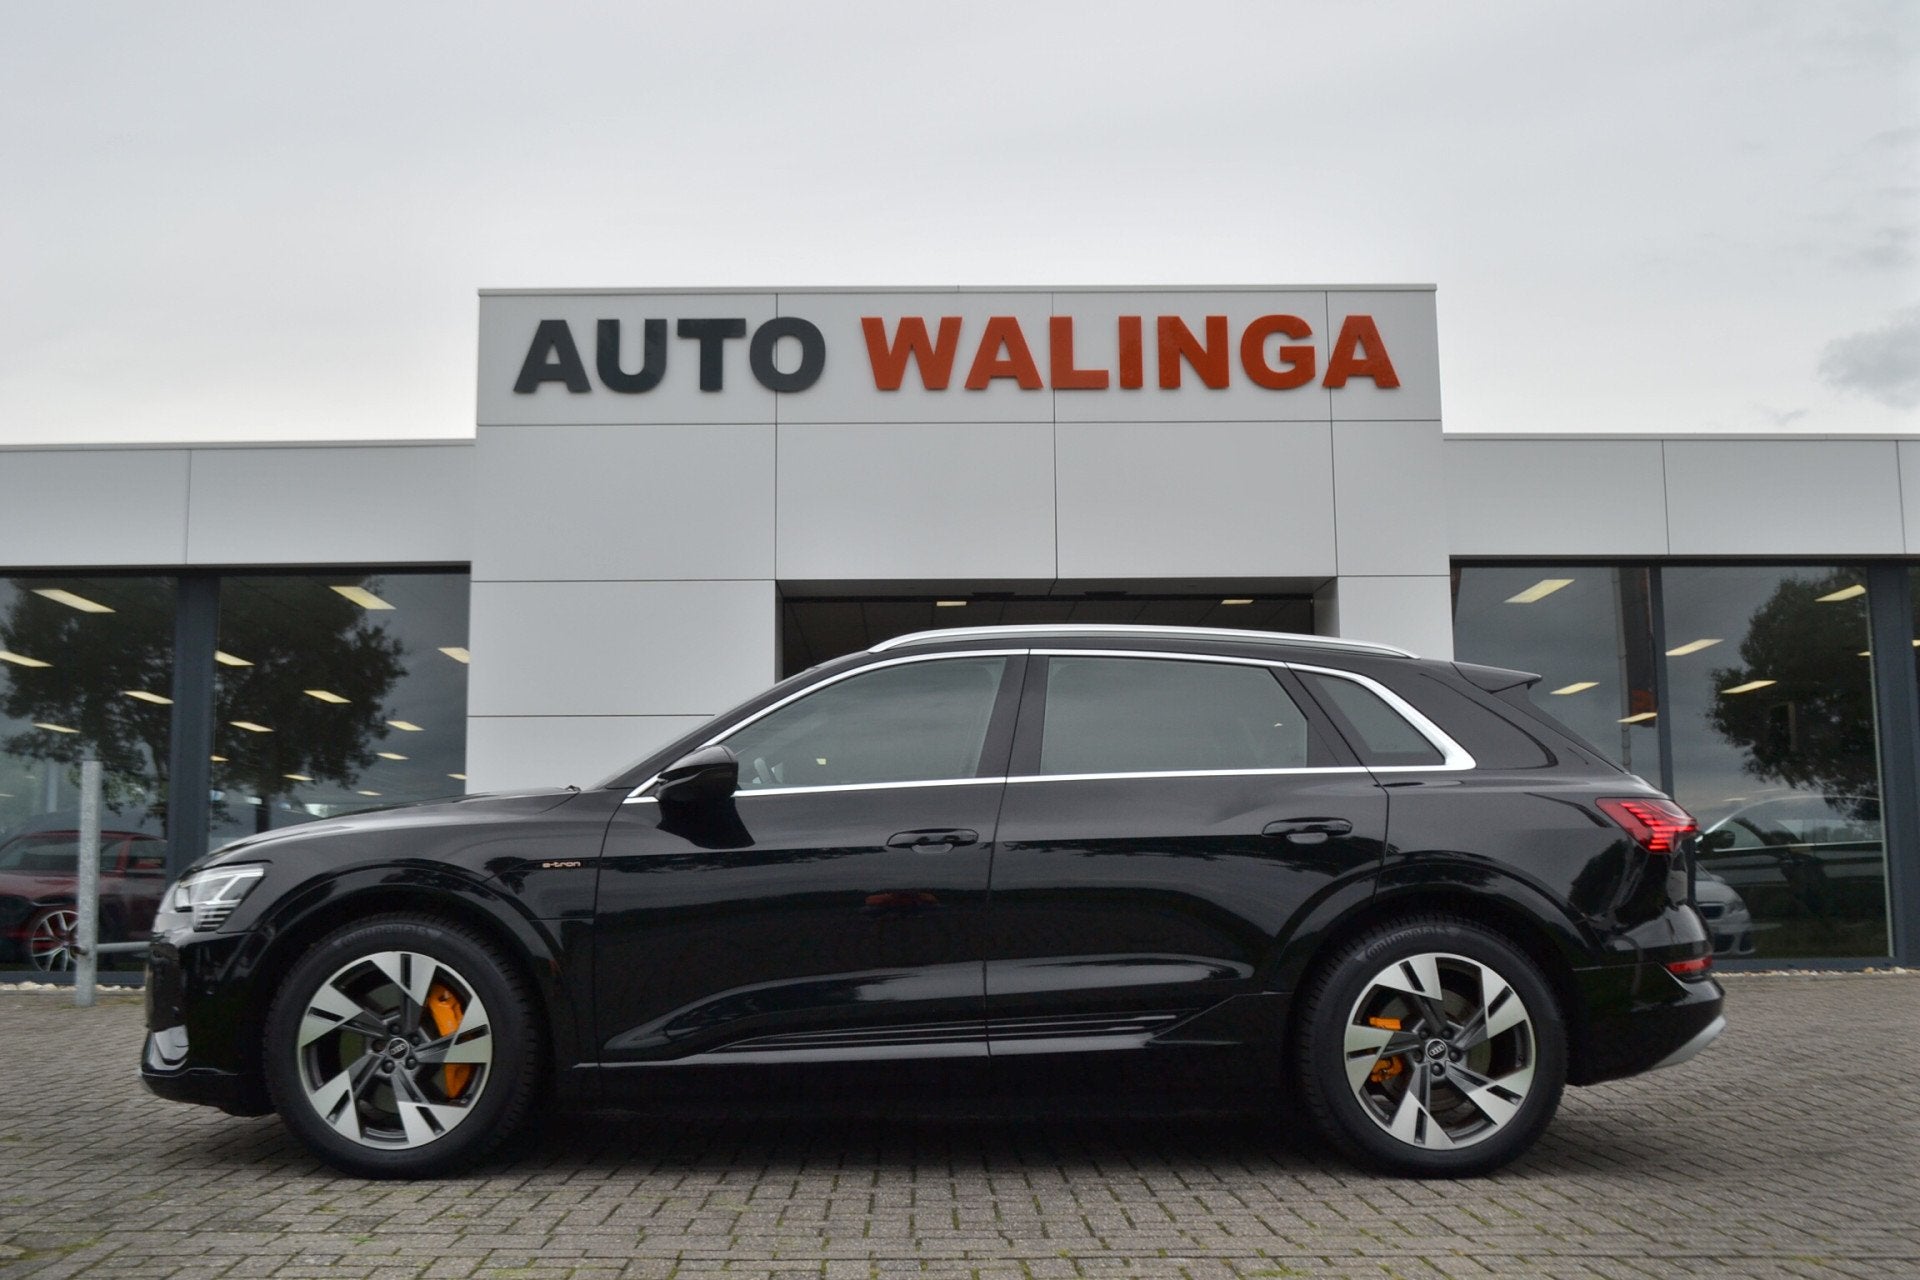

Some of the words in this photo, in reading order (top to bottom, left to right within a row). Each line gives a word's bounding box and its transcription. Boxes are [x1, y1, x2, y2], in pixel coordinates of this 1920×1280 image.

[513, 318, 826, 394] AUTO
[861, 315, 1400, 392] WALINGA
[542, 861, 581, 869] e-tron
